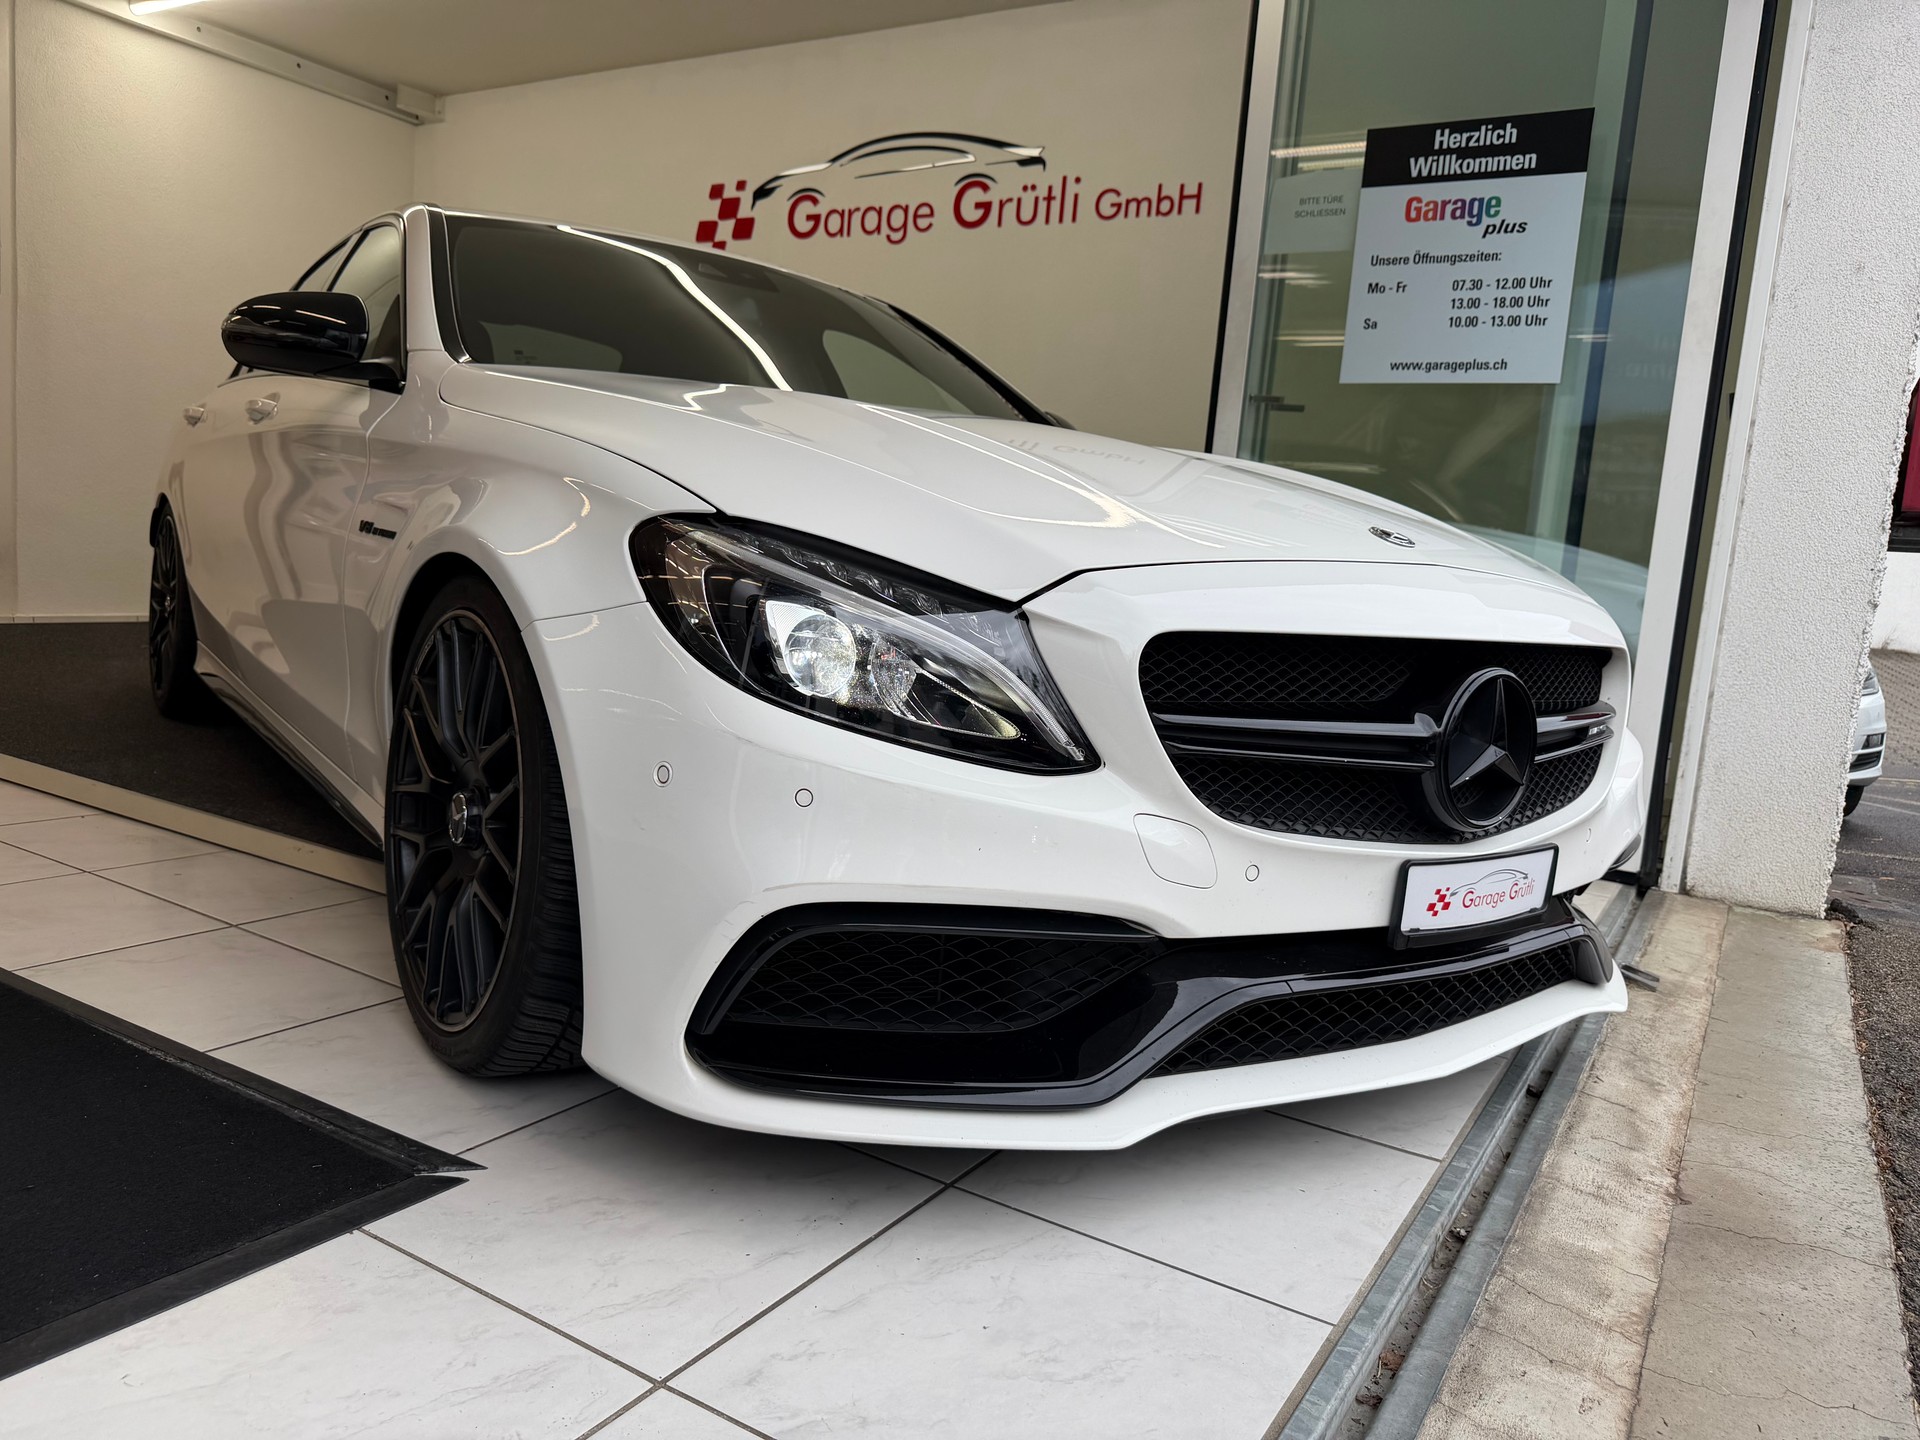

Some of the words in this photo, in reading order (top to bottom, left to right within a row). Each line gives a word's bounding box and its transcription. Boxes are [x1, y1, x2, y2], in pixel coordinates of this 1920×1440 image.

[1433, 123, 1518, 150] Herzlich
[1409, 153, 1537, 178] Willkommen
[1299, 197, 1320, 206] BITTE
[1323, 195, 1343, 204] TÜRE
[787, 194, 934, 244] Garage
[953, 176, 1080, 229] Grütli
[1094, 182, 1203, 220] GmbH
[1294, 208, 1346, 218] SCHLIESSEN
[1404, 195, 1502, 227] Garage
[1482, 219, 1527, 238] plus
[1371, 255, 1409, 266] Unsere
[1413, 250, 1501, 266] Öffnungszeiten:
[1368, 283, 1385, 294] Mo
[1396, 282, 1407, 293] Fr
[1452, 279, 1483, 291] 07.30
[1495, 278, 1526, 290] 12.00
[1530, 277, 1552, 288] Uhr
[1451, 298, 1480, 309] 13.00
[1493, 296, 1524, 308] 18.00
[1528, 296, 1550, 307] Uhr
[1363, 318, 1377, 330] Sa
[1449, 316, 1478, 328] 10.00
[1490, 315, 1521, 327] 13.00
[1525, 314, 1548, 326] Uhr
[1390, 358, 1507, 373] www.garageplus.ch
[1462, 890, 1506, 909] Garage
[1509, 879, 1535, 900] Grütli
